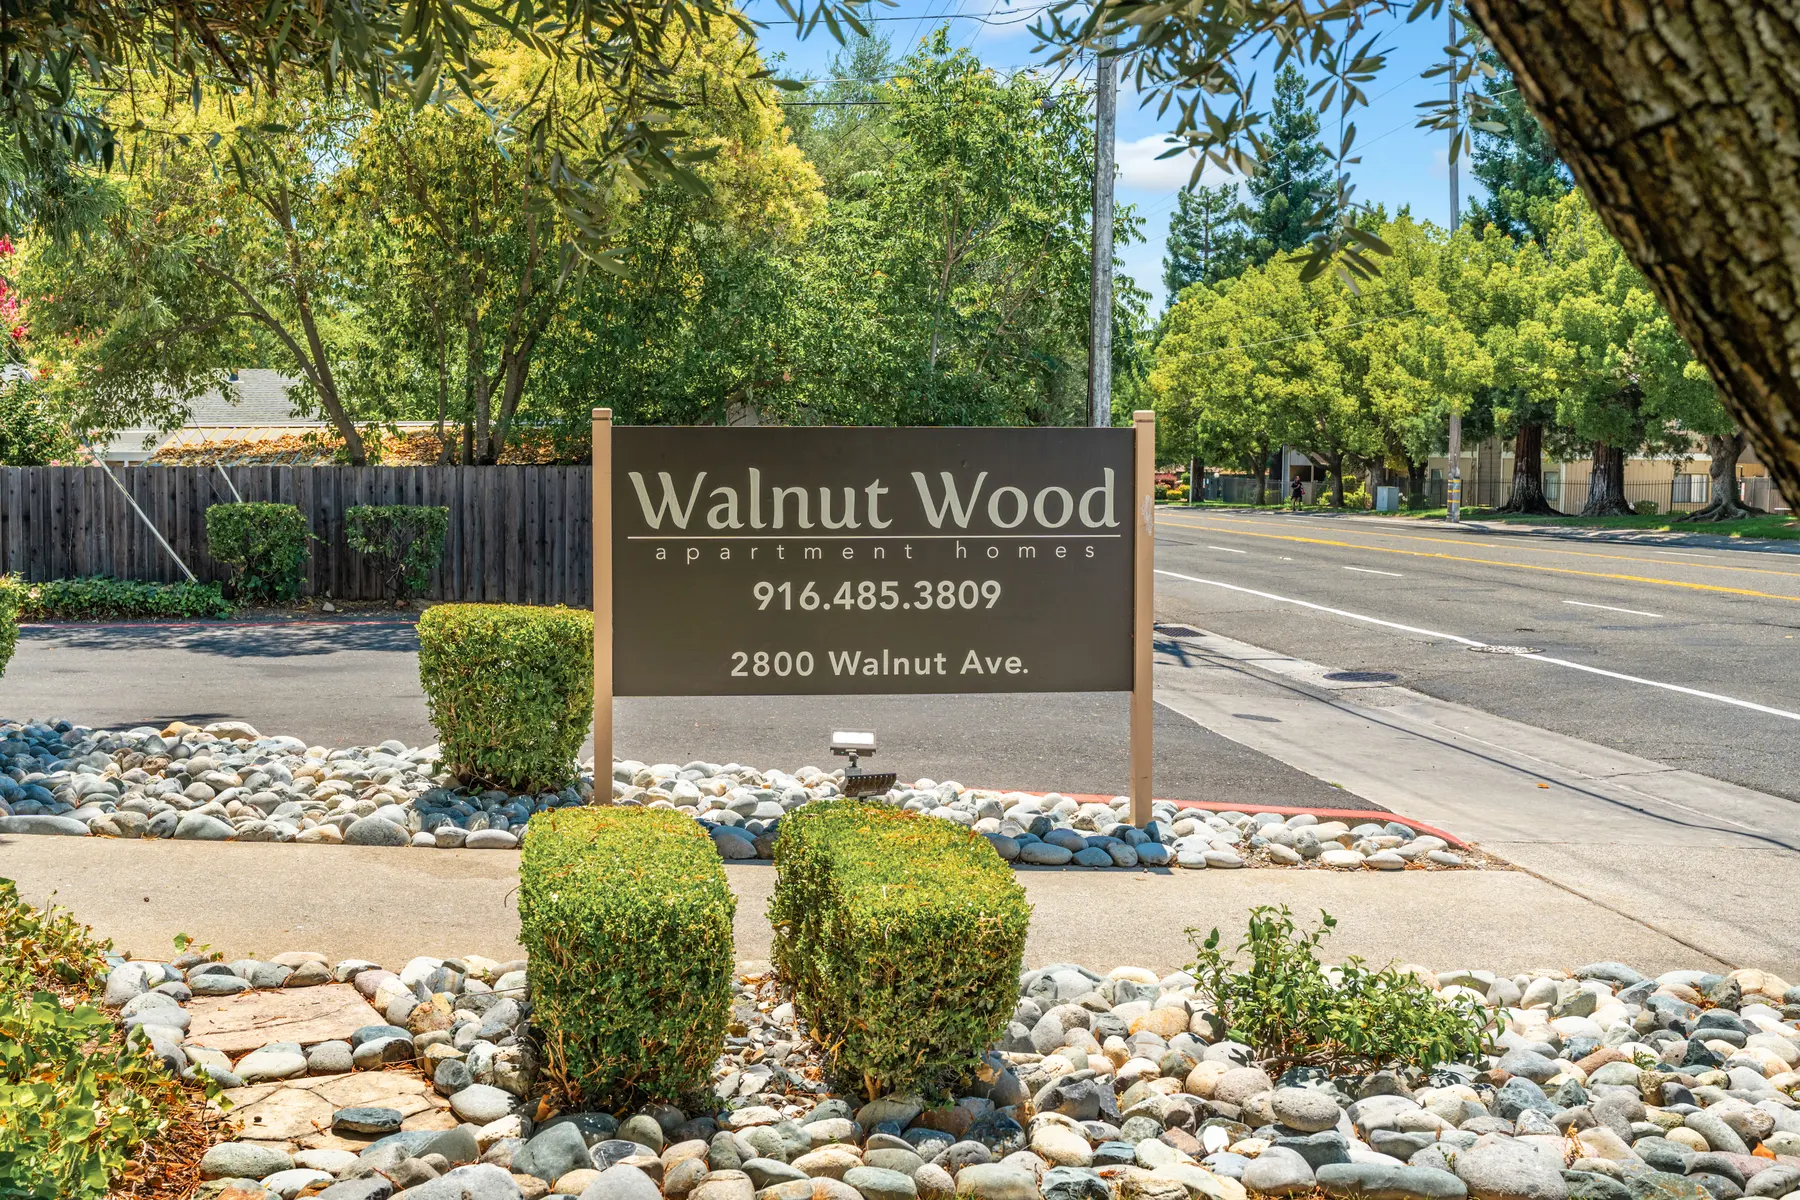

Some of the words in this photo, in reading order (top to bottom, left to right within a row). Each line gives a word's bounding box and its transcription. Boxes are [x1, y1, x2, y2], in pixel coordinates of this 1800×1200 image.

[628, 468, 893, 530] Walnut
[911, 468, 1121, 529] Wood
[655, 544, 914, 565] apartment
[956, 540, 1096, 560] homes
[753, 580, 1002, 611] 916.485.3809
[730, 651, 815, 678] 2800
[828, 650, 947, 676] Walnut
[960, 650, 1029, 675] Ave.
